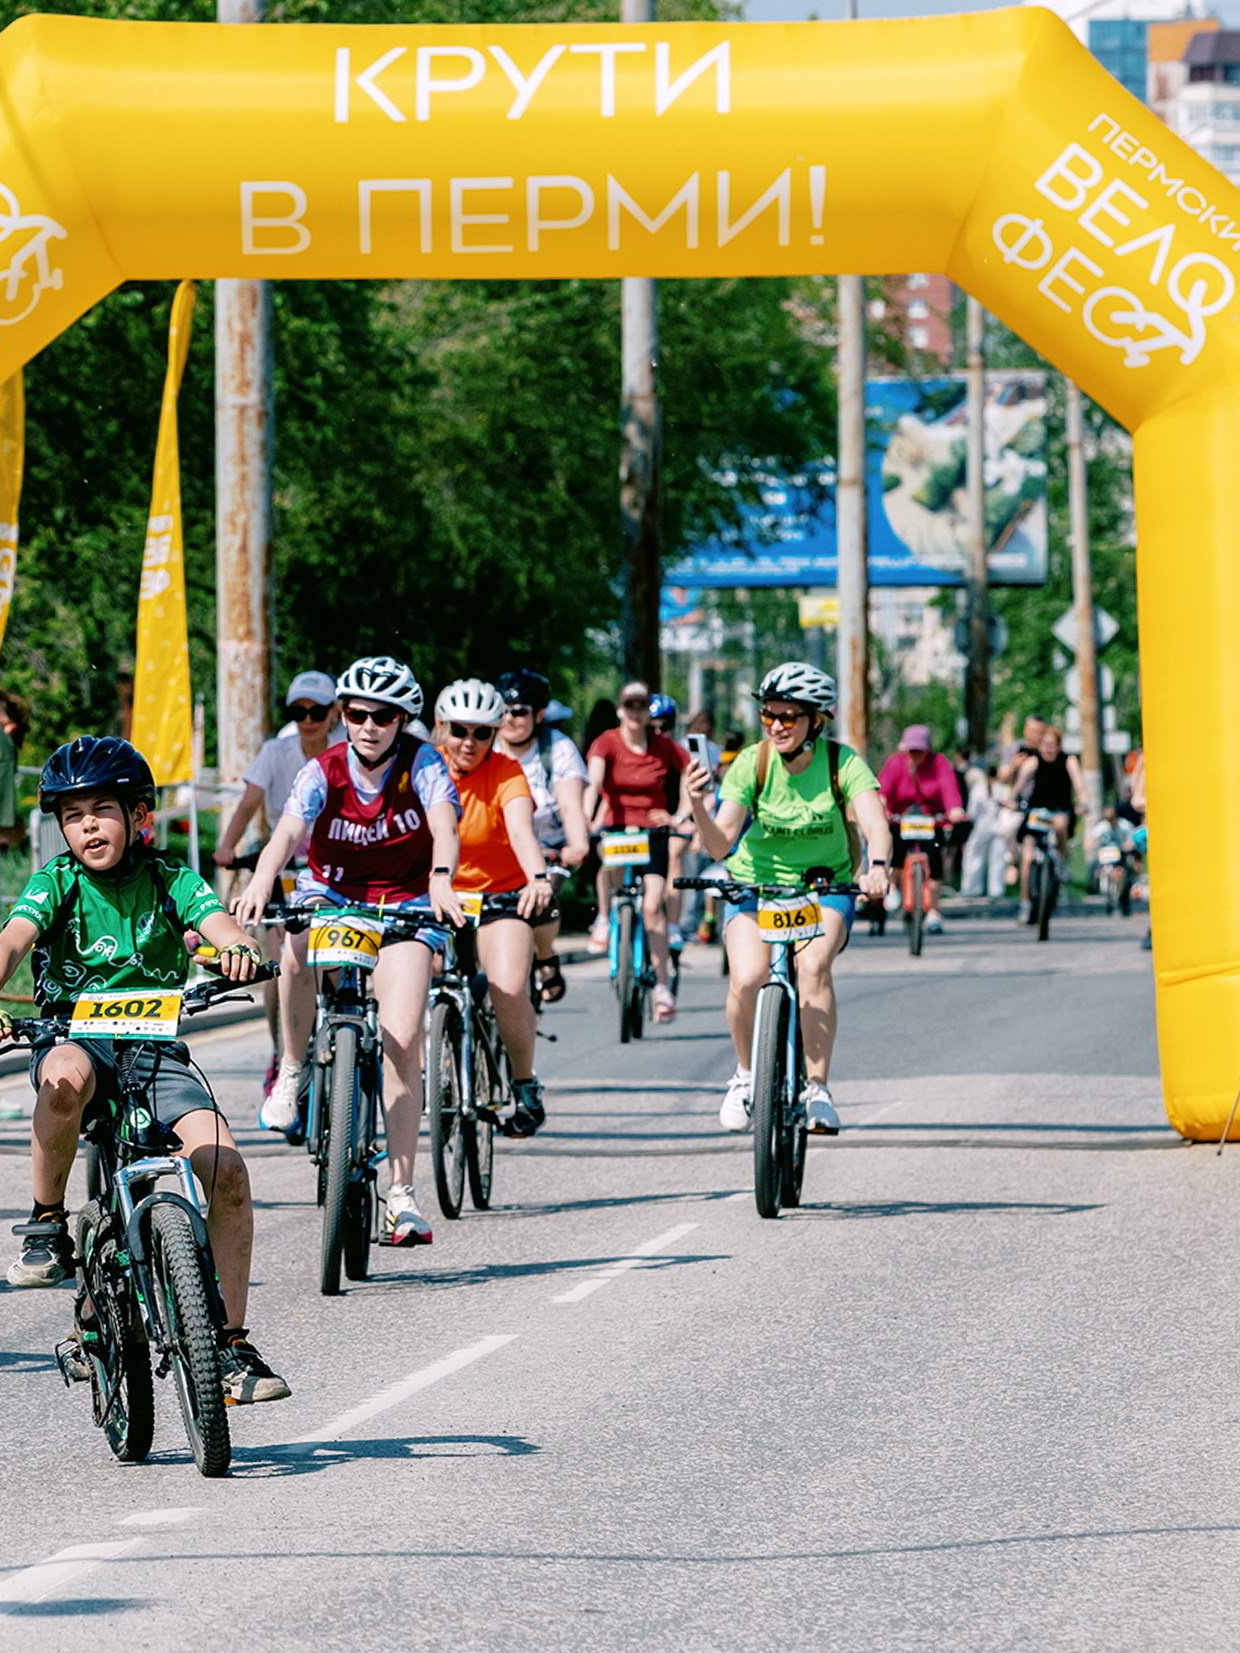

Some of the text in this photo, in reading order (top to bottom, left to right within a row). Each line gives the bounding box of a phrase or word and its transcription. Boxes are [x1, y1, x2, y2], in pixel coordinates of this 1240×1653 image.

[333, 39, 733, 124] КРУТИ
[1087, 112, 1240, 252] ПЕРМСКИ
[240, 163, 828, 256] В ПЕРМИ!
[327, 808, 421, 846] ЛИЦЕЙ 10
[773, 910, 807, 929] 816
[327, 929, 366, 949] 967
[89, 999, 163, 1018] 1602
